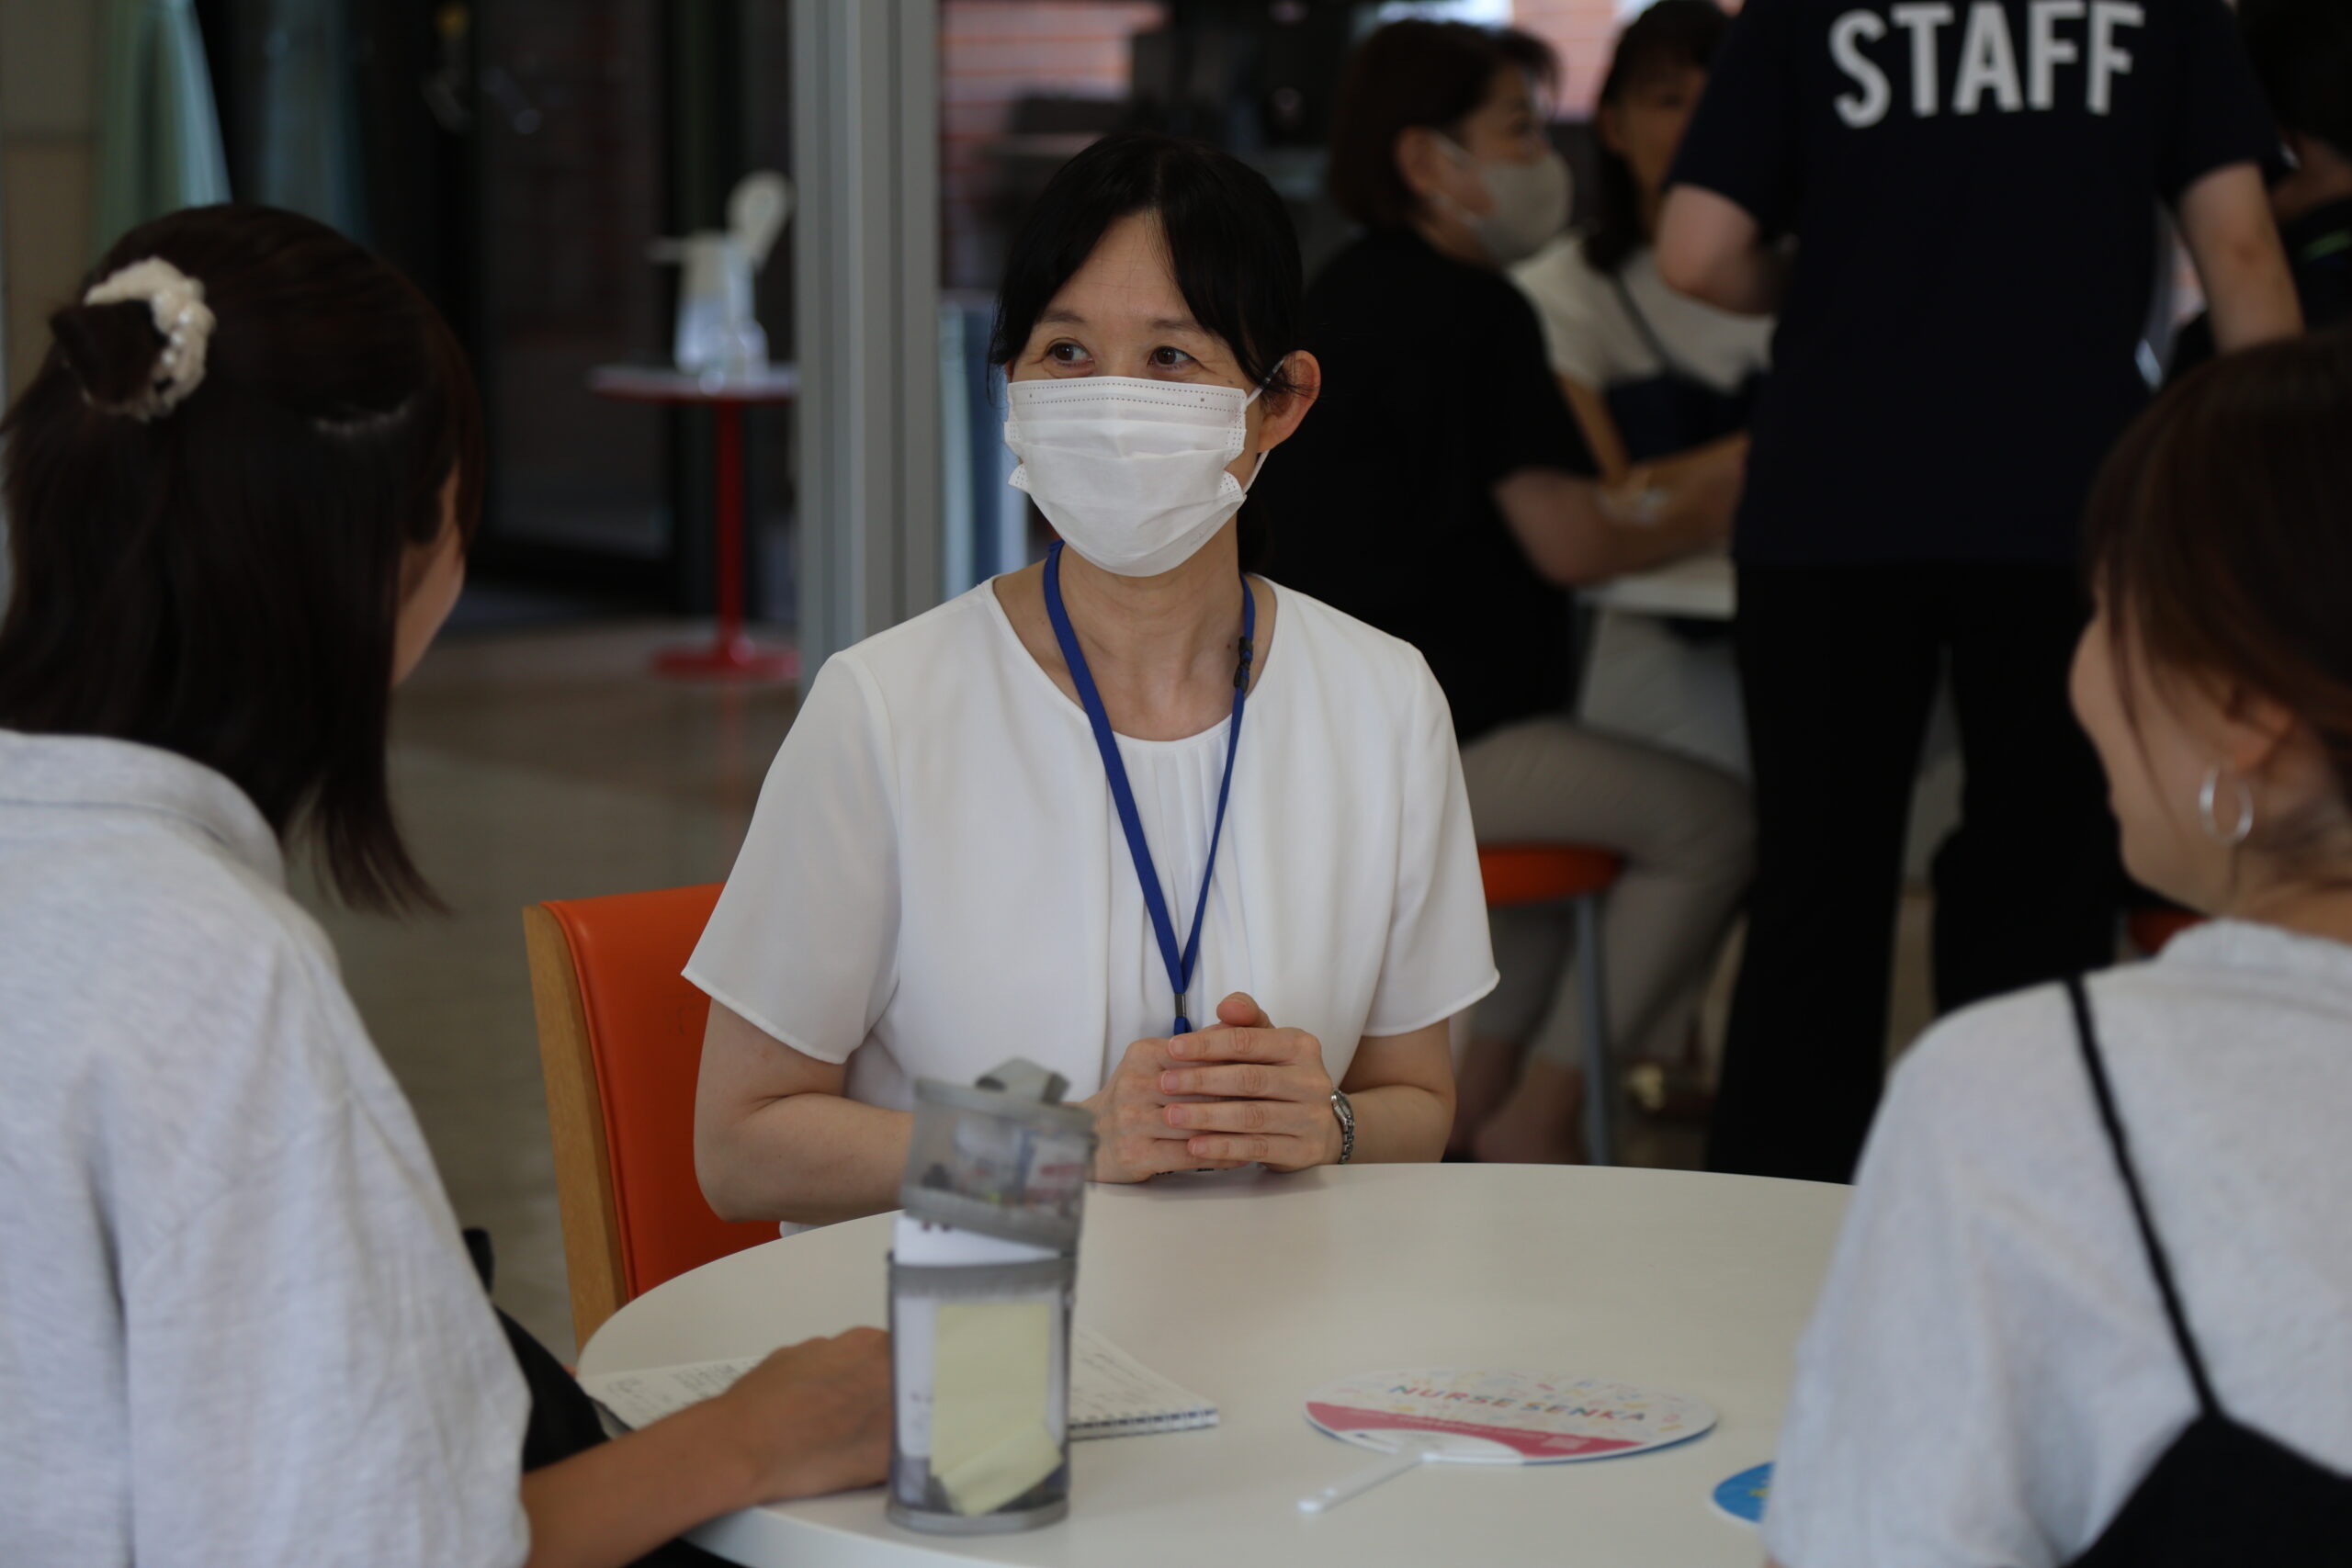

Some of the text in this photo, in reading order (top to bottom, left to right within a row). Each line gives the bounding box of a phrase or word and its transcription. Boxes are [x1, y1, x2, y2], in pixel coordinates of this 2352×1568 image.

[1829, 0, 2144, 128] STAFF
[1388, 1385, 1645, 1421] NURSE SENKA
